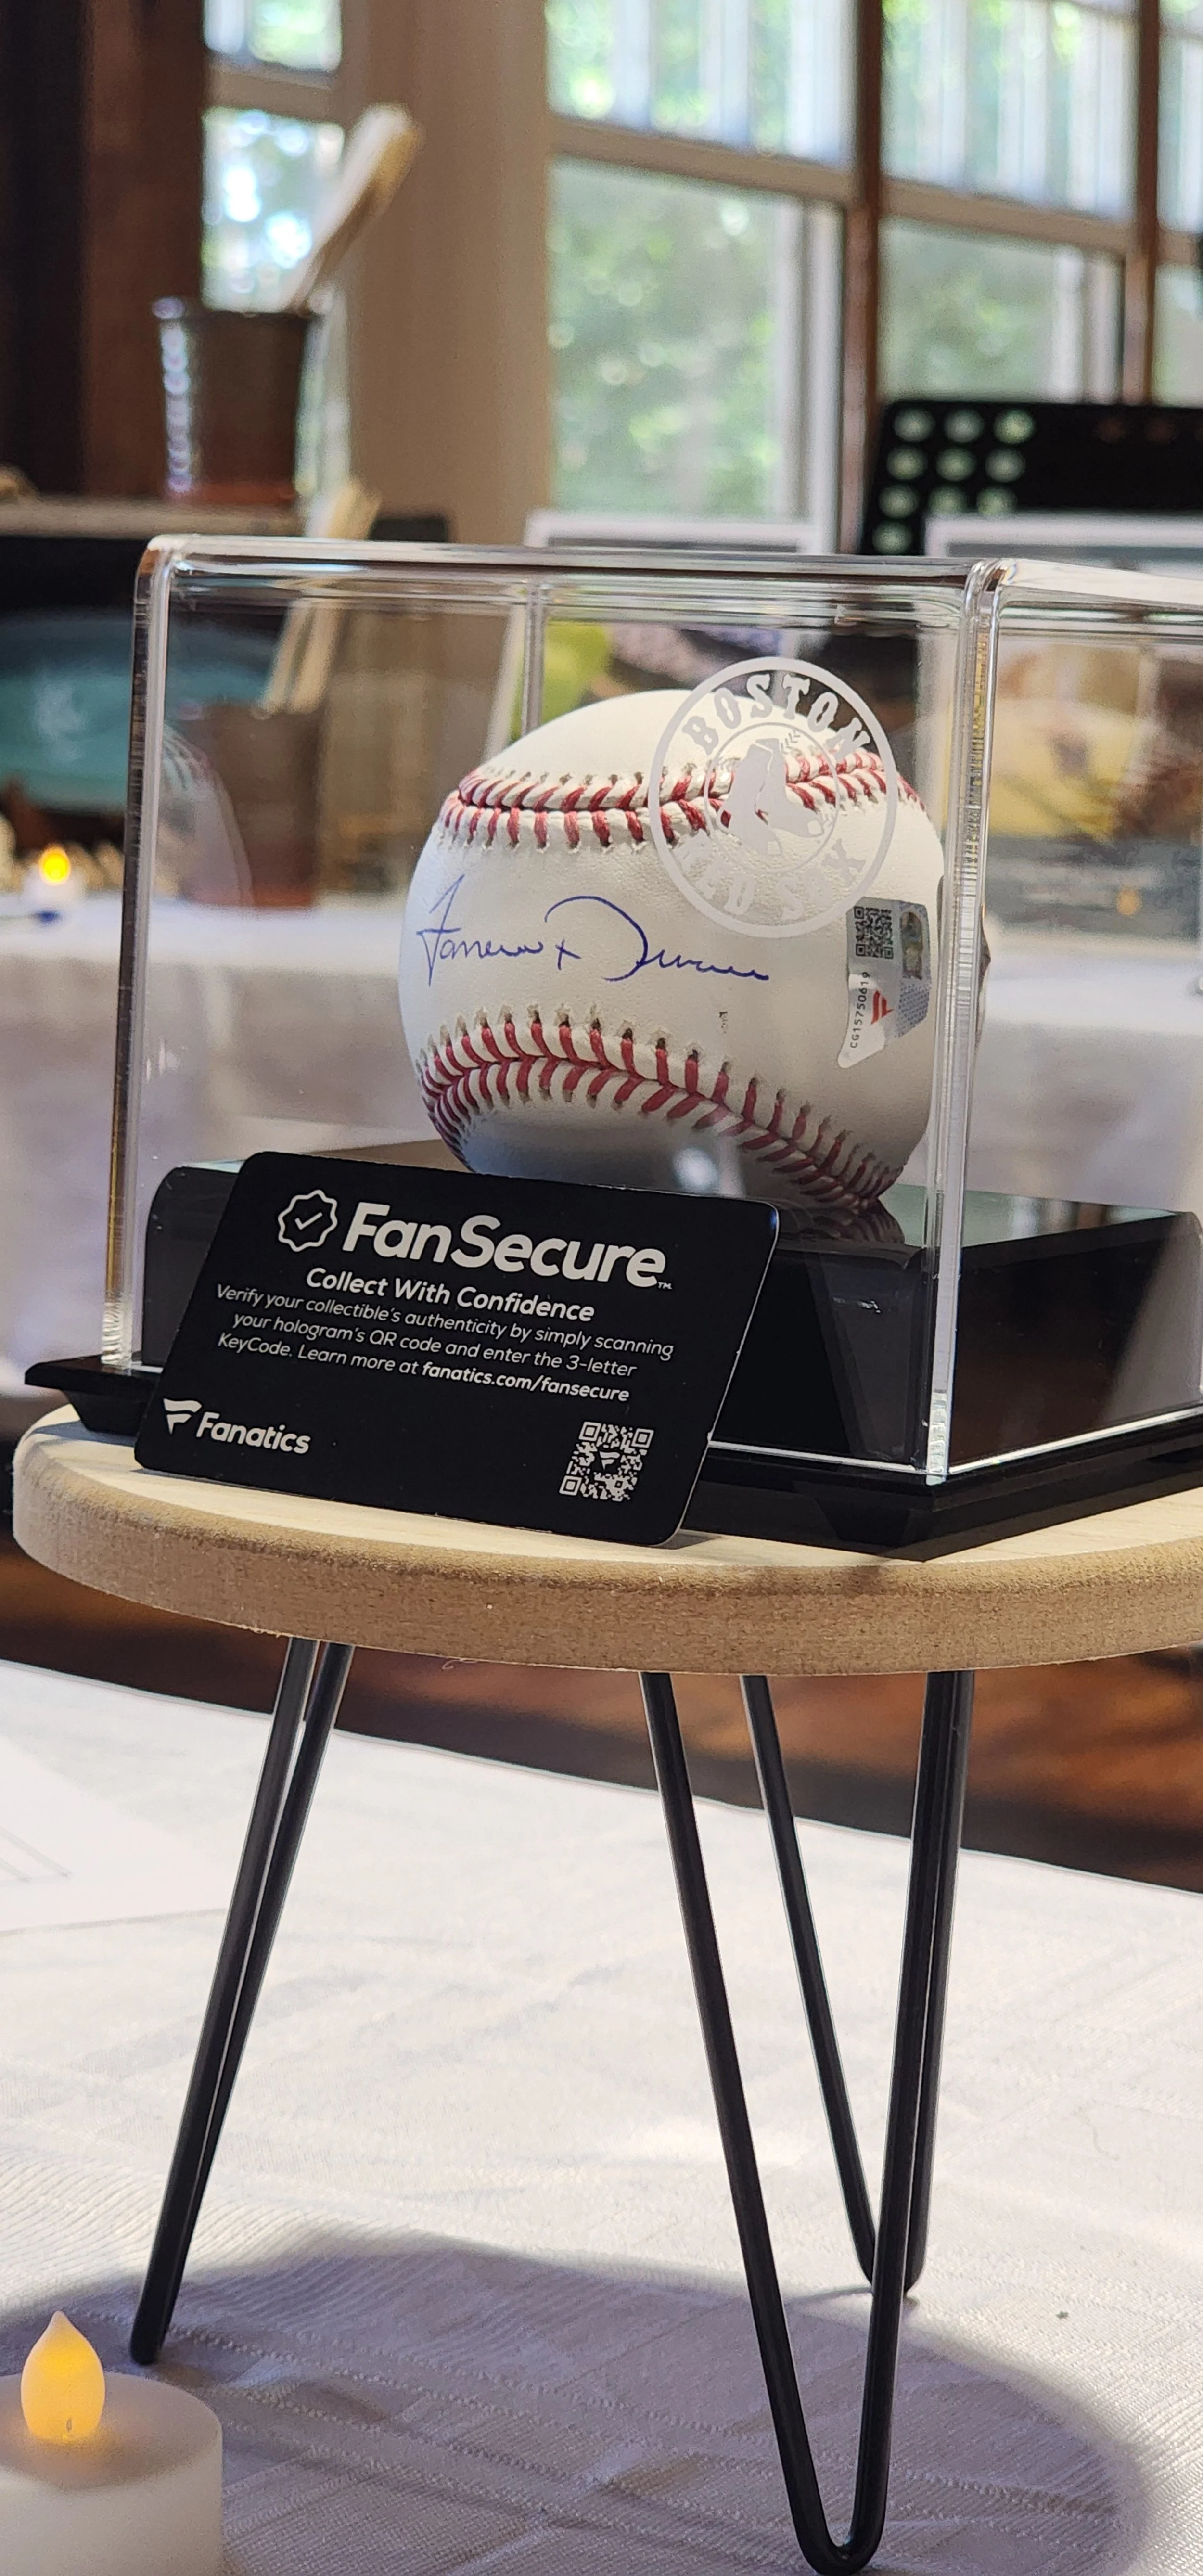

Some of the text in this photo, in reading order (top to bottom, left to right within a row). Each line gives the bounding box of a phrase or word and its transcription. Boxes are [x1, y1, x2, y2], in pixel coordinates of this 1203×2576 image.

[682, 673, 870, 759] BOSTON
[781, 838, 867, 917] SOX
[849, 971, 870, 1049] CG15750619
[218, 1284, 674, 1361] Verify your collectible's authenticity by simply scanning
[307, 1267, 595, 1321] Collect With Confidence
[218, 1333, 629, 1401] KeyCode. Learn more at fanatics.com/fansecure
[232, 1314, 637, 1376] your hologram's QR code and enter the 3-letter
[196, 1411, 311, 1455] Fanatics
